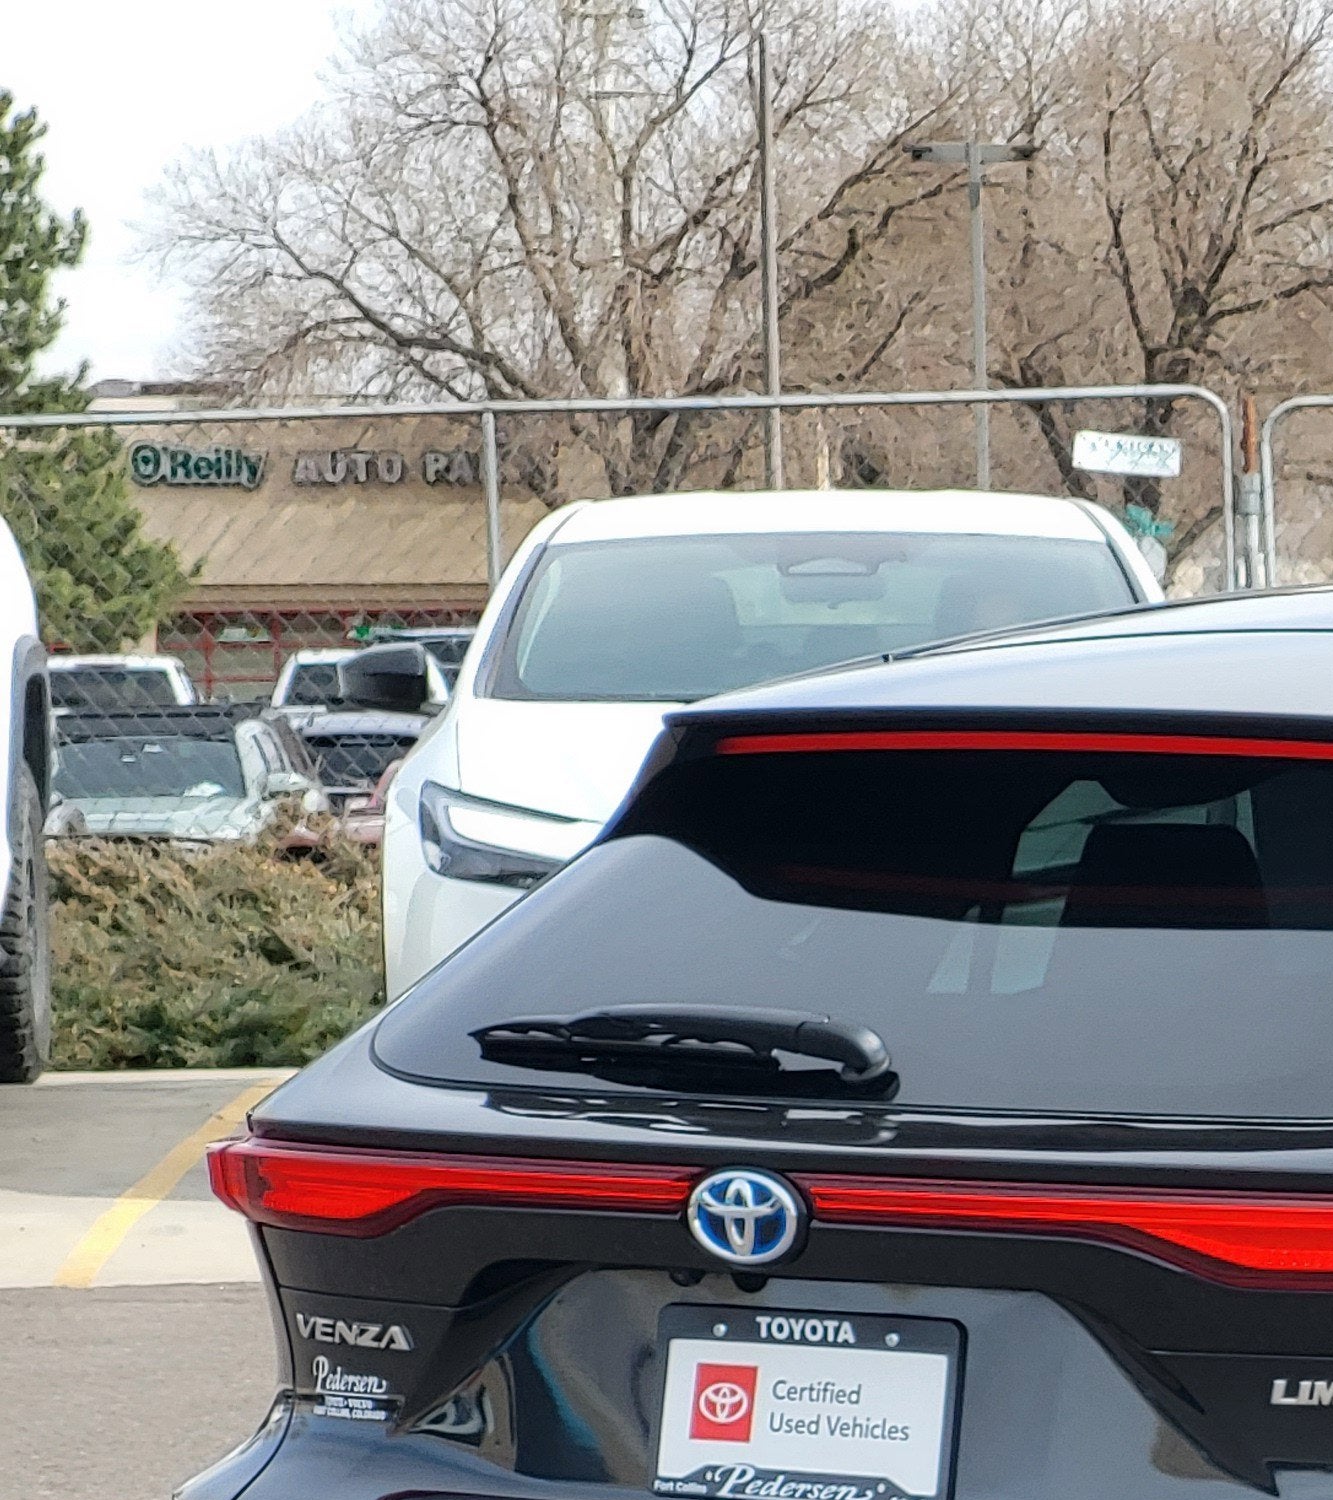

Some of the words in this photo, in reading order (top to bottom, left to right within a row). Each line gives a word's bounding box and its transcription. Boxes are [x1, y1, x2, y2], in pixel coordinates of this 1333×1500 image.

[130, 441, 266, 489] O'Reilly
[293, 450, 404, 484] AUTO
[296, 1312, 415, 1351] VENZA
[755, 1316, 856, 1344] TOYOTA
[313, 1355, 388, 1394] Pedersen
[772, 1379, 862, 1405] Certified
[769, 1412, 820, 1436] Used
[827, 1415, 910, 1442] Vehicles
